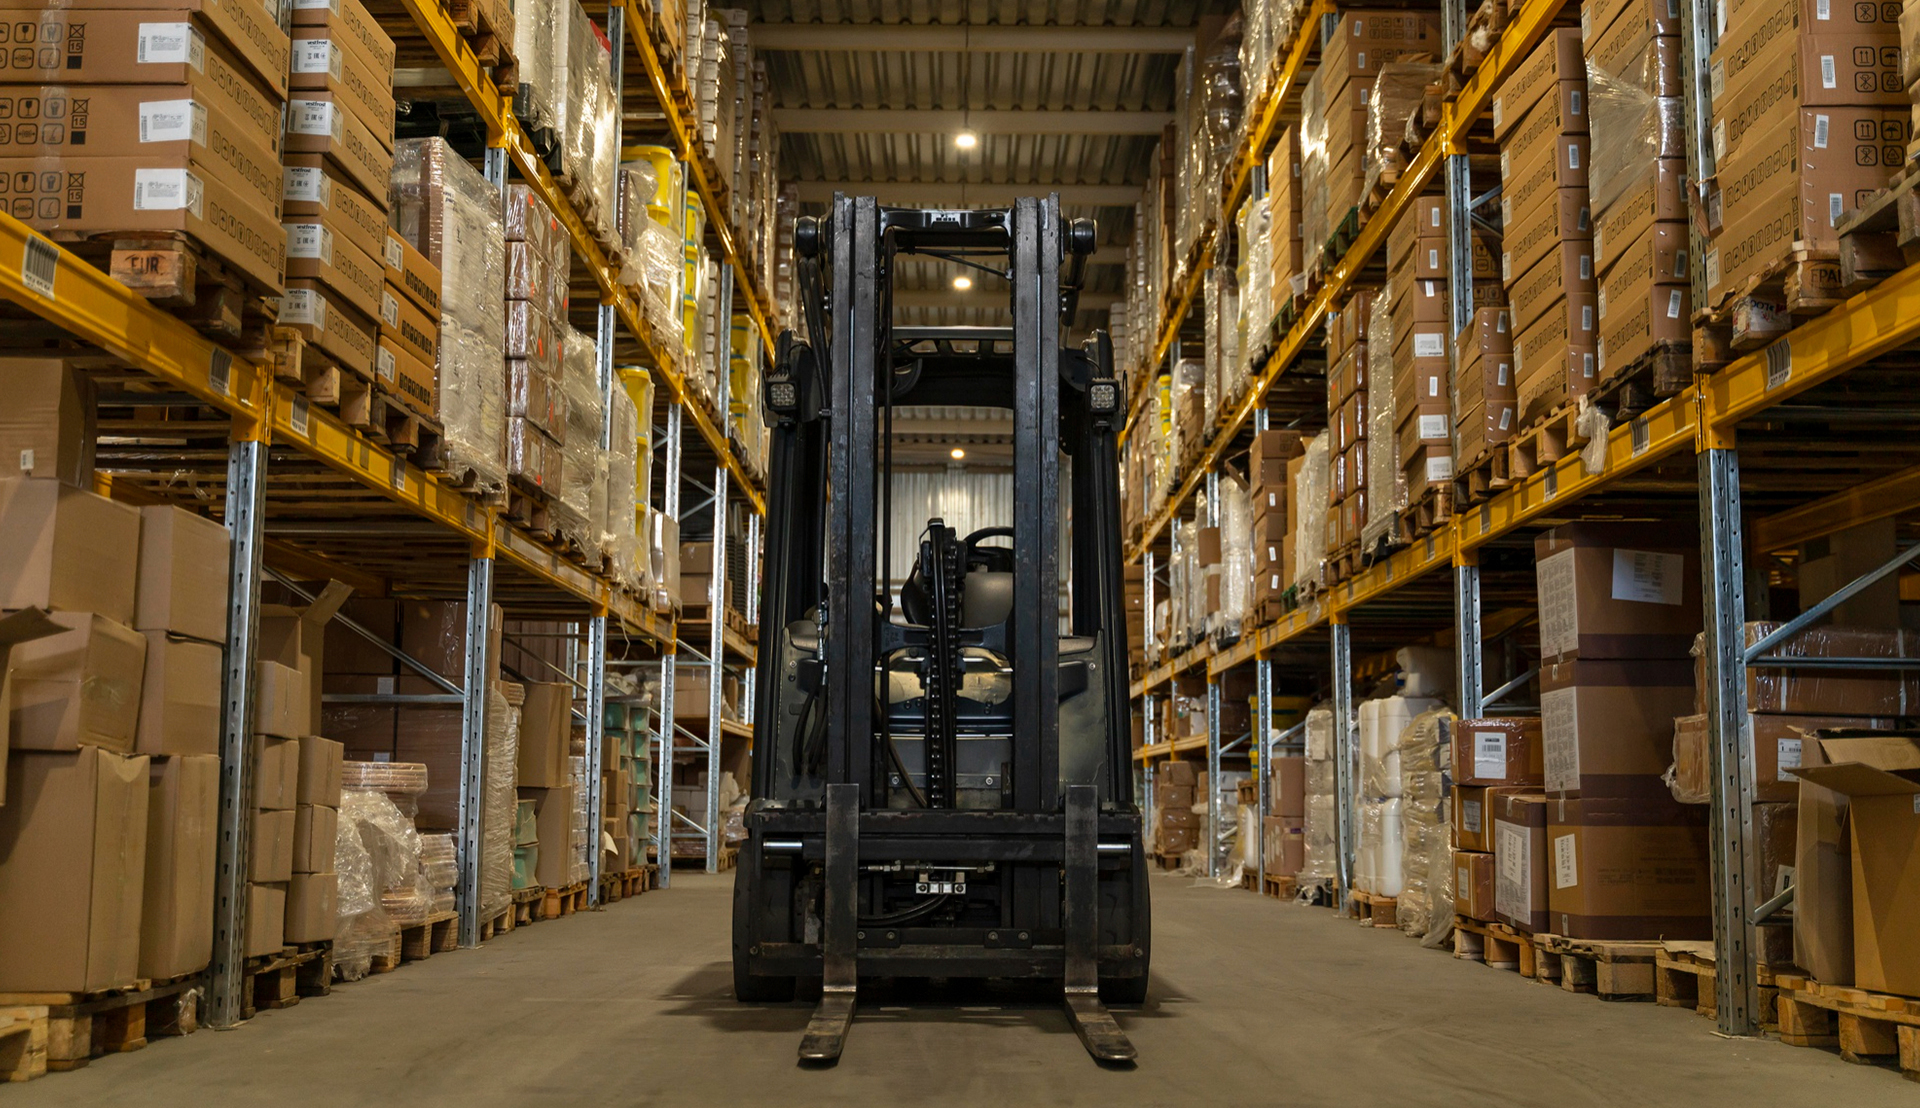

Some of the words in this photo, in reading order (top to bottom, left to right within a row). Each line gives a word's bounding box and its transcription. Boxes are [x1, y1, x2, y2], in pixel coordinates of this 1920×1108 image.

[70, 42, 81, 51] 15
[74, 117, 85, 126] 15
[70, 191, 81, 200] 15
